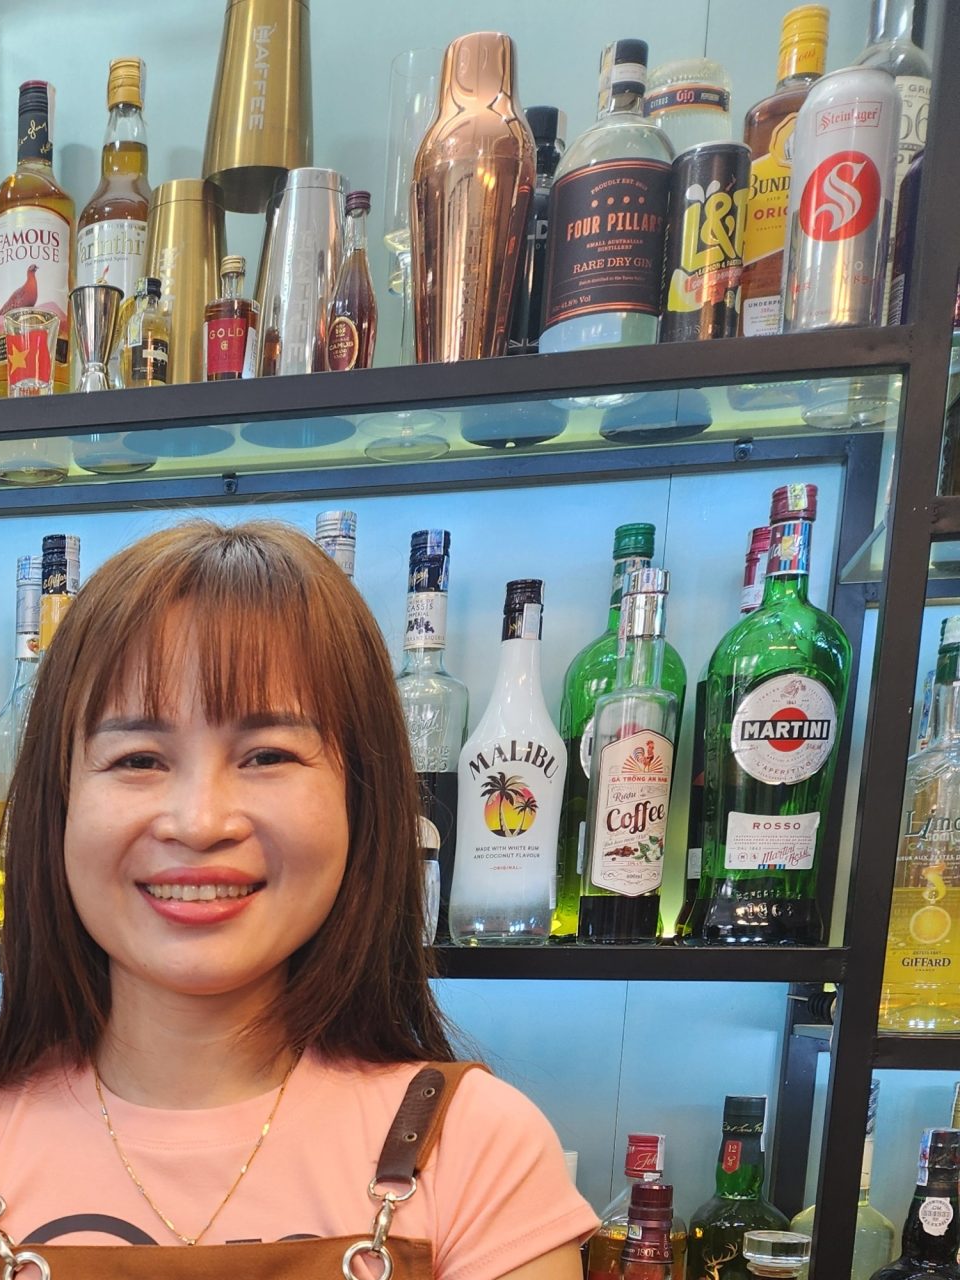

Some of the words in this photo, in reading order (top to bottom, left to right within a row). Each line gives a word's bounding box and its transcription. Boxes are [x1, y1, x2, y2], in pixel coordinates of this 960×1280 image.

[748, 172, 791, 200] BUND
[566, 214, 601, 242] FOUR
[606, 211, 664, 233] PILLARS
[572, 258, 605, 274] RARE
[607, 256, 633, 269] DRY
[633, 257, 652, 268] GIN
[209, 327, 245, 340] GOLD
[406, 603, 434, 613] CASSIS
[743, 721, 828, 740] MARTINI
[606, 800, 666, 835] Coffee
[752, 821, 801, 831] ROSSO
[727, 1143, 738, 1153] 12
